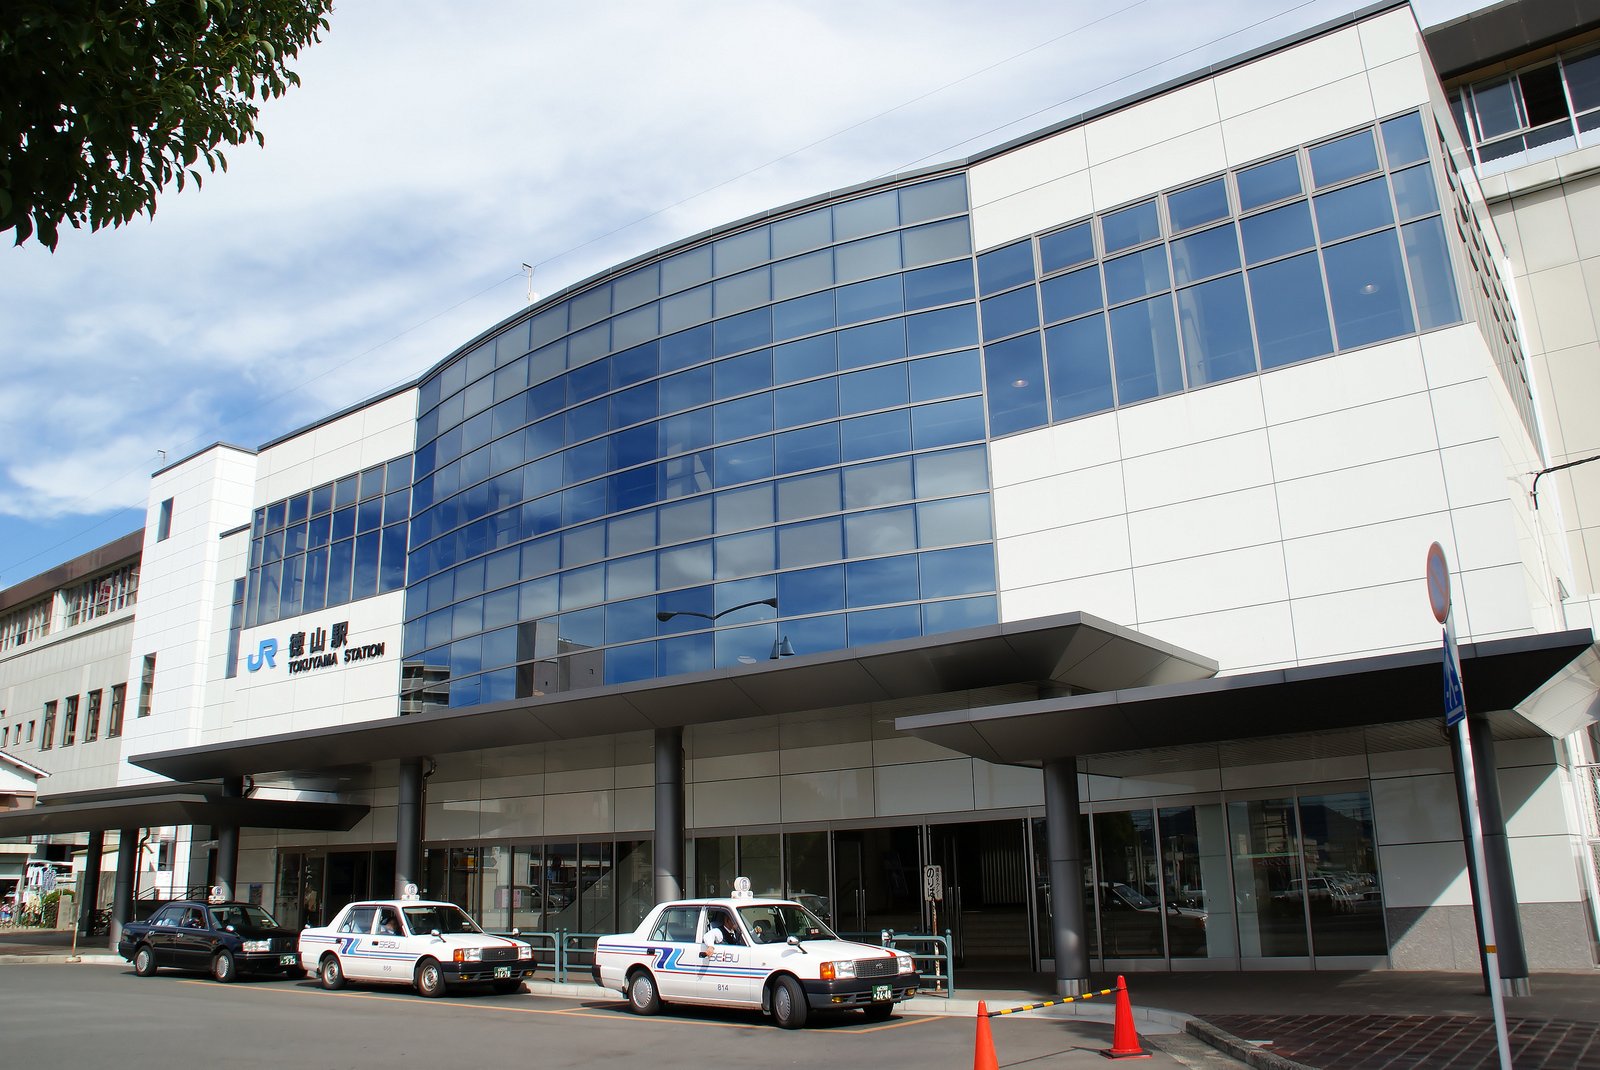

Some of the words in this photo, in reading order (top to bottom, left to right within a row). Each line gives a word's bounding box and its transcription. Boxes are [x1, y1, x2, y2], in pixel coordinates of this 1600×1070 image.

[247, 638, 279, 672] JR
[289, 621, 349, 658] 徳山駅
[288, 652, 338, 675] TOKUYAMA
[344, 642, 385, 663] STATION
[717, 983, 729, 991] 814
